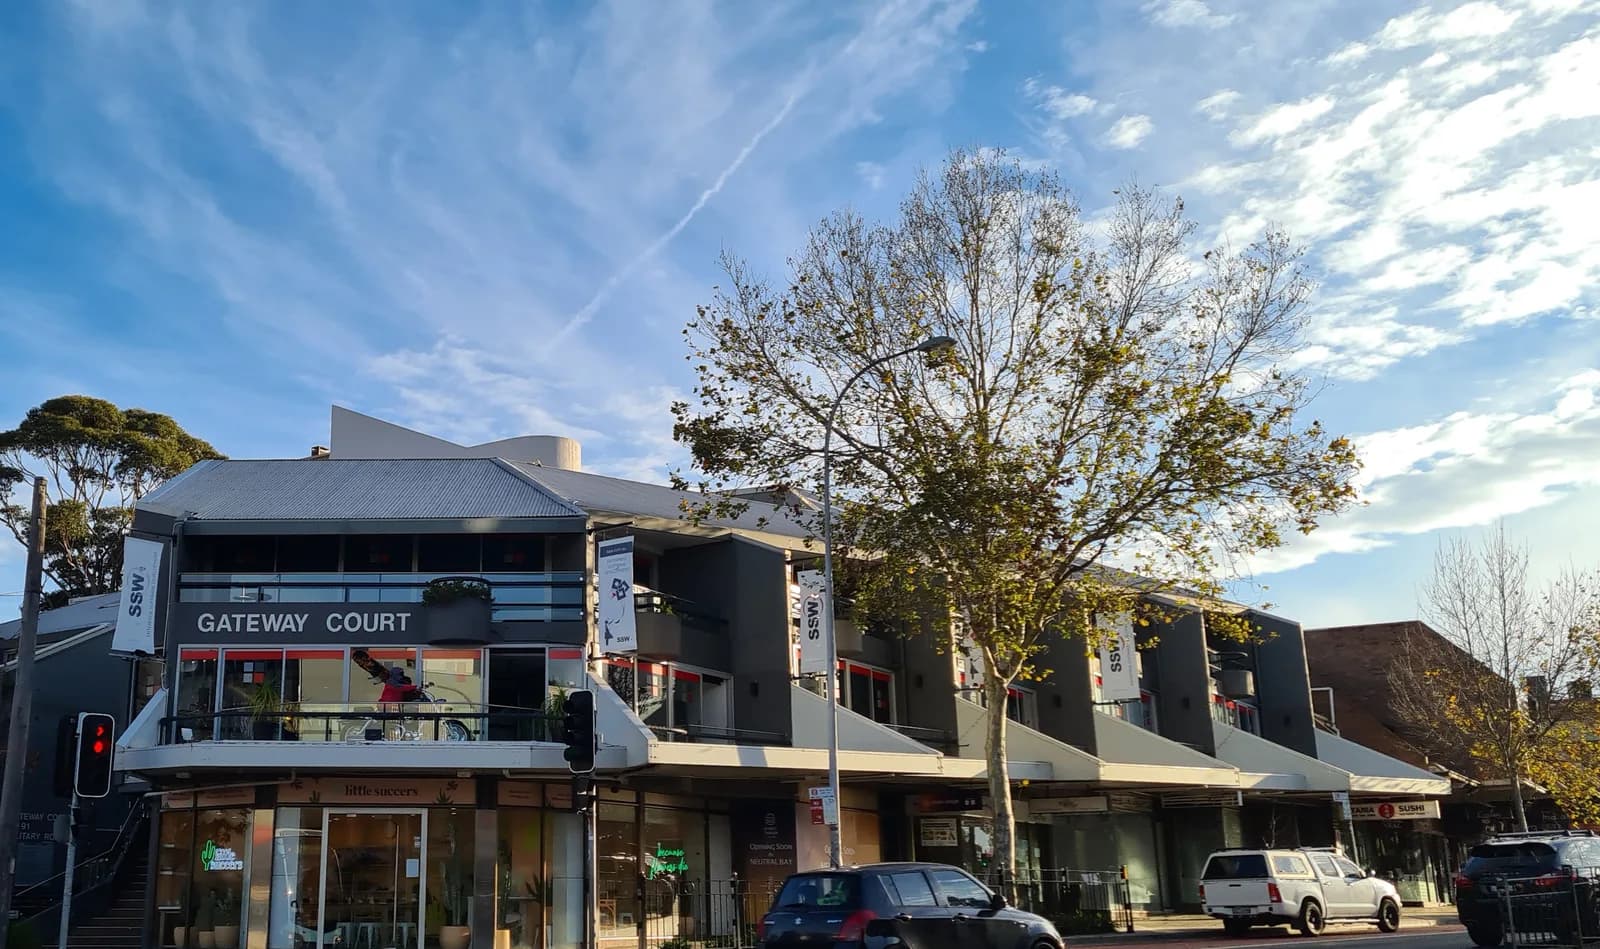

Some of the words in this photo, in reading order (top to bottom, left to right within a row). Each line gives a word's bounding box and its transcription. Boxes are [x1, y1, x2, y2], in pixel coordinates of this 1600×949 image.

[129, 573, 145, 618] SSW
[197, 612, 309, 633] GATEWAY
[326, 611, 411, 633] COURT
[807, 601, 819, 641] SSW
[345, 784, 373, 797] little
[374, 785, 418, 797] succers
[18, 812, 44, 822] TEWAY
[1398, 804, 1425, 813] SUSHI
